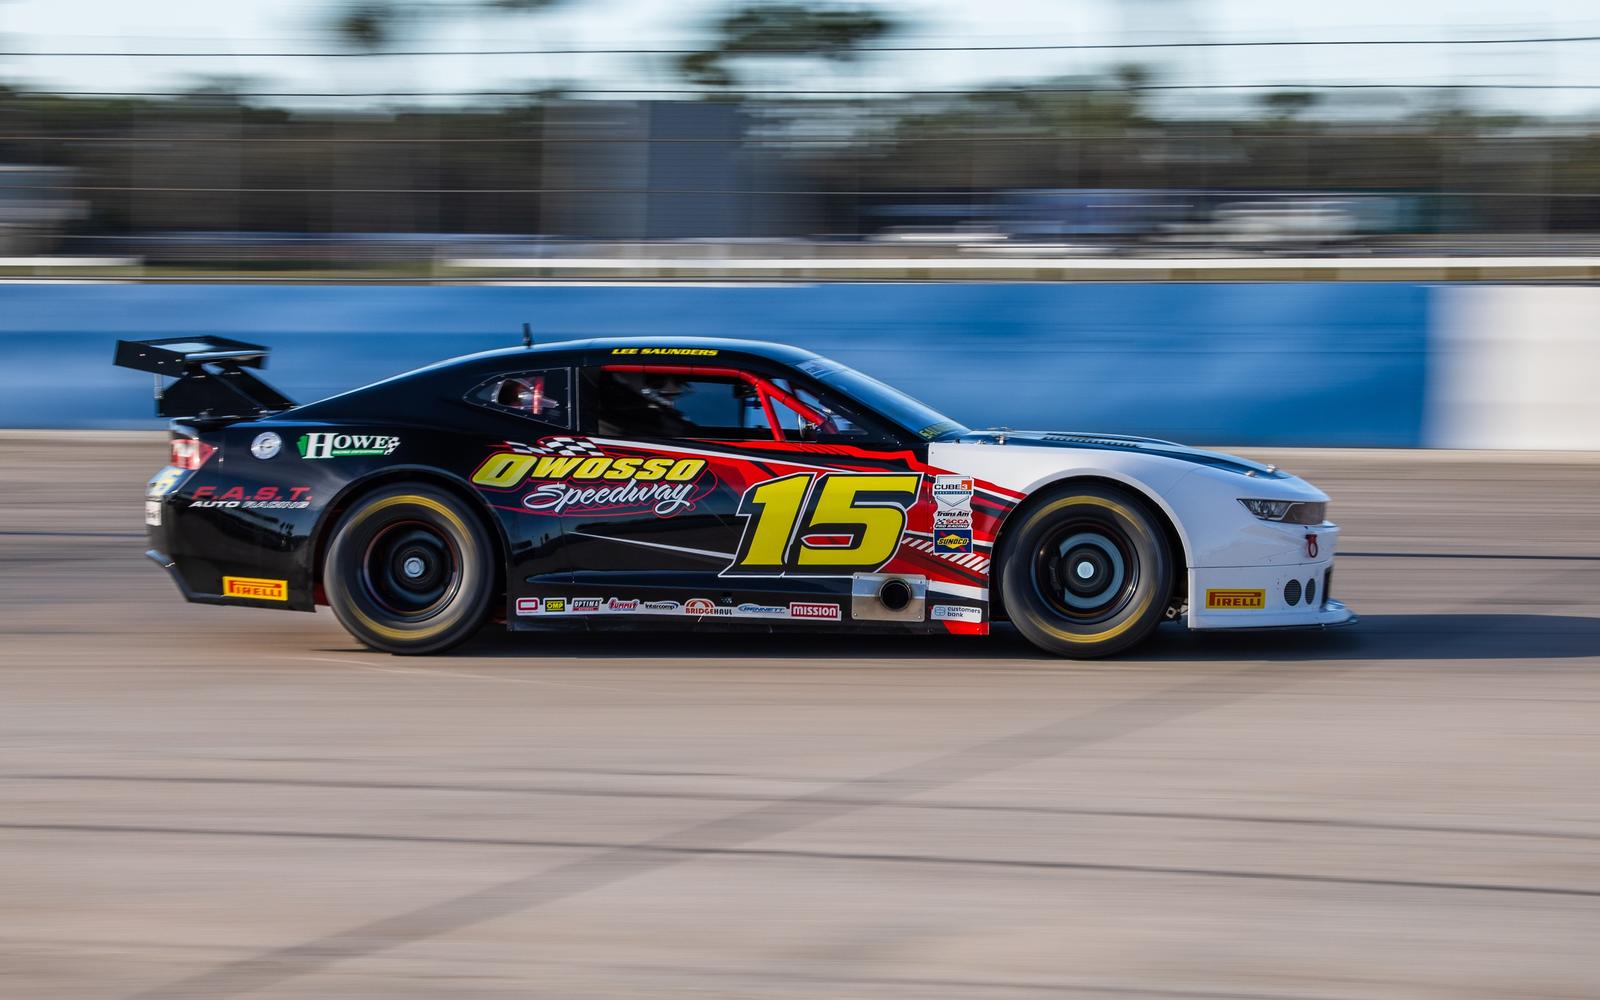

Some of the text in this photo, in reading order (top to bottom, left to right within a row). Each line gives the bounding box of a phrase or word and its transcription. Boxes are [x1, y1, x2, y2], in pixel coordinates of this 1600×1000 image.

[640, 348, 720, 356] SAUNDERS
[302, 432, 388, 459] HOWE
[191, 486, 313, 500] F.A.S.T.
[523, 477, 693, 514] Speedway
[241, 501, 310, 509] RACING
[737, 474, 921, 568] 15
[228, 580, 283, 598] PIRELLI
[574, 600, 598, 608] OPTIMA
[1209, 591, 1262, 606] PIRELLI
[645, 602, 676, 610] Intercomp
[685, 607, 733, 615] BRIDGEHAUL
[947, 606, 981, 614] customers
